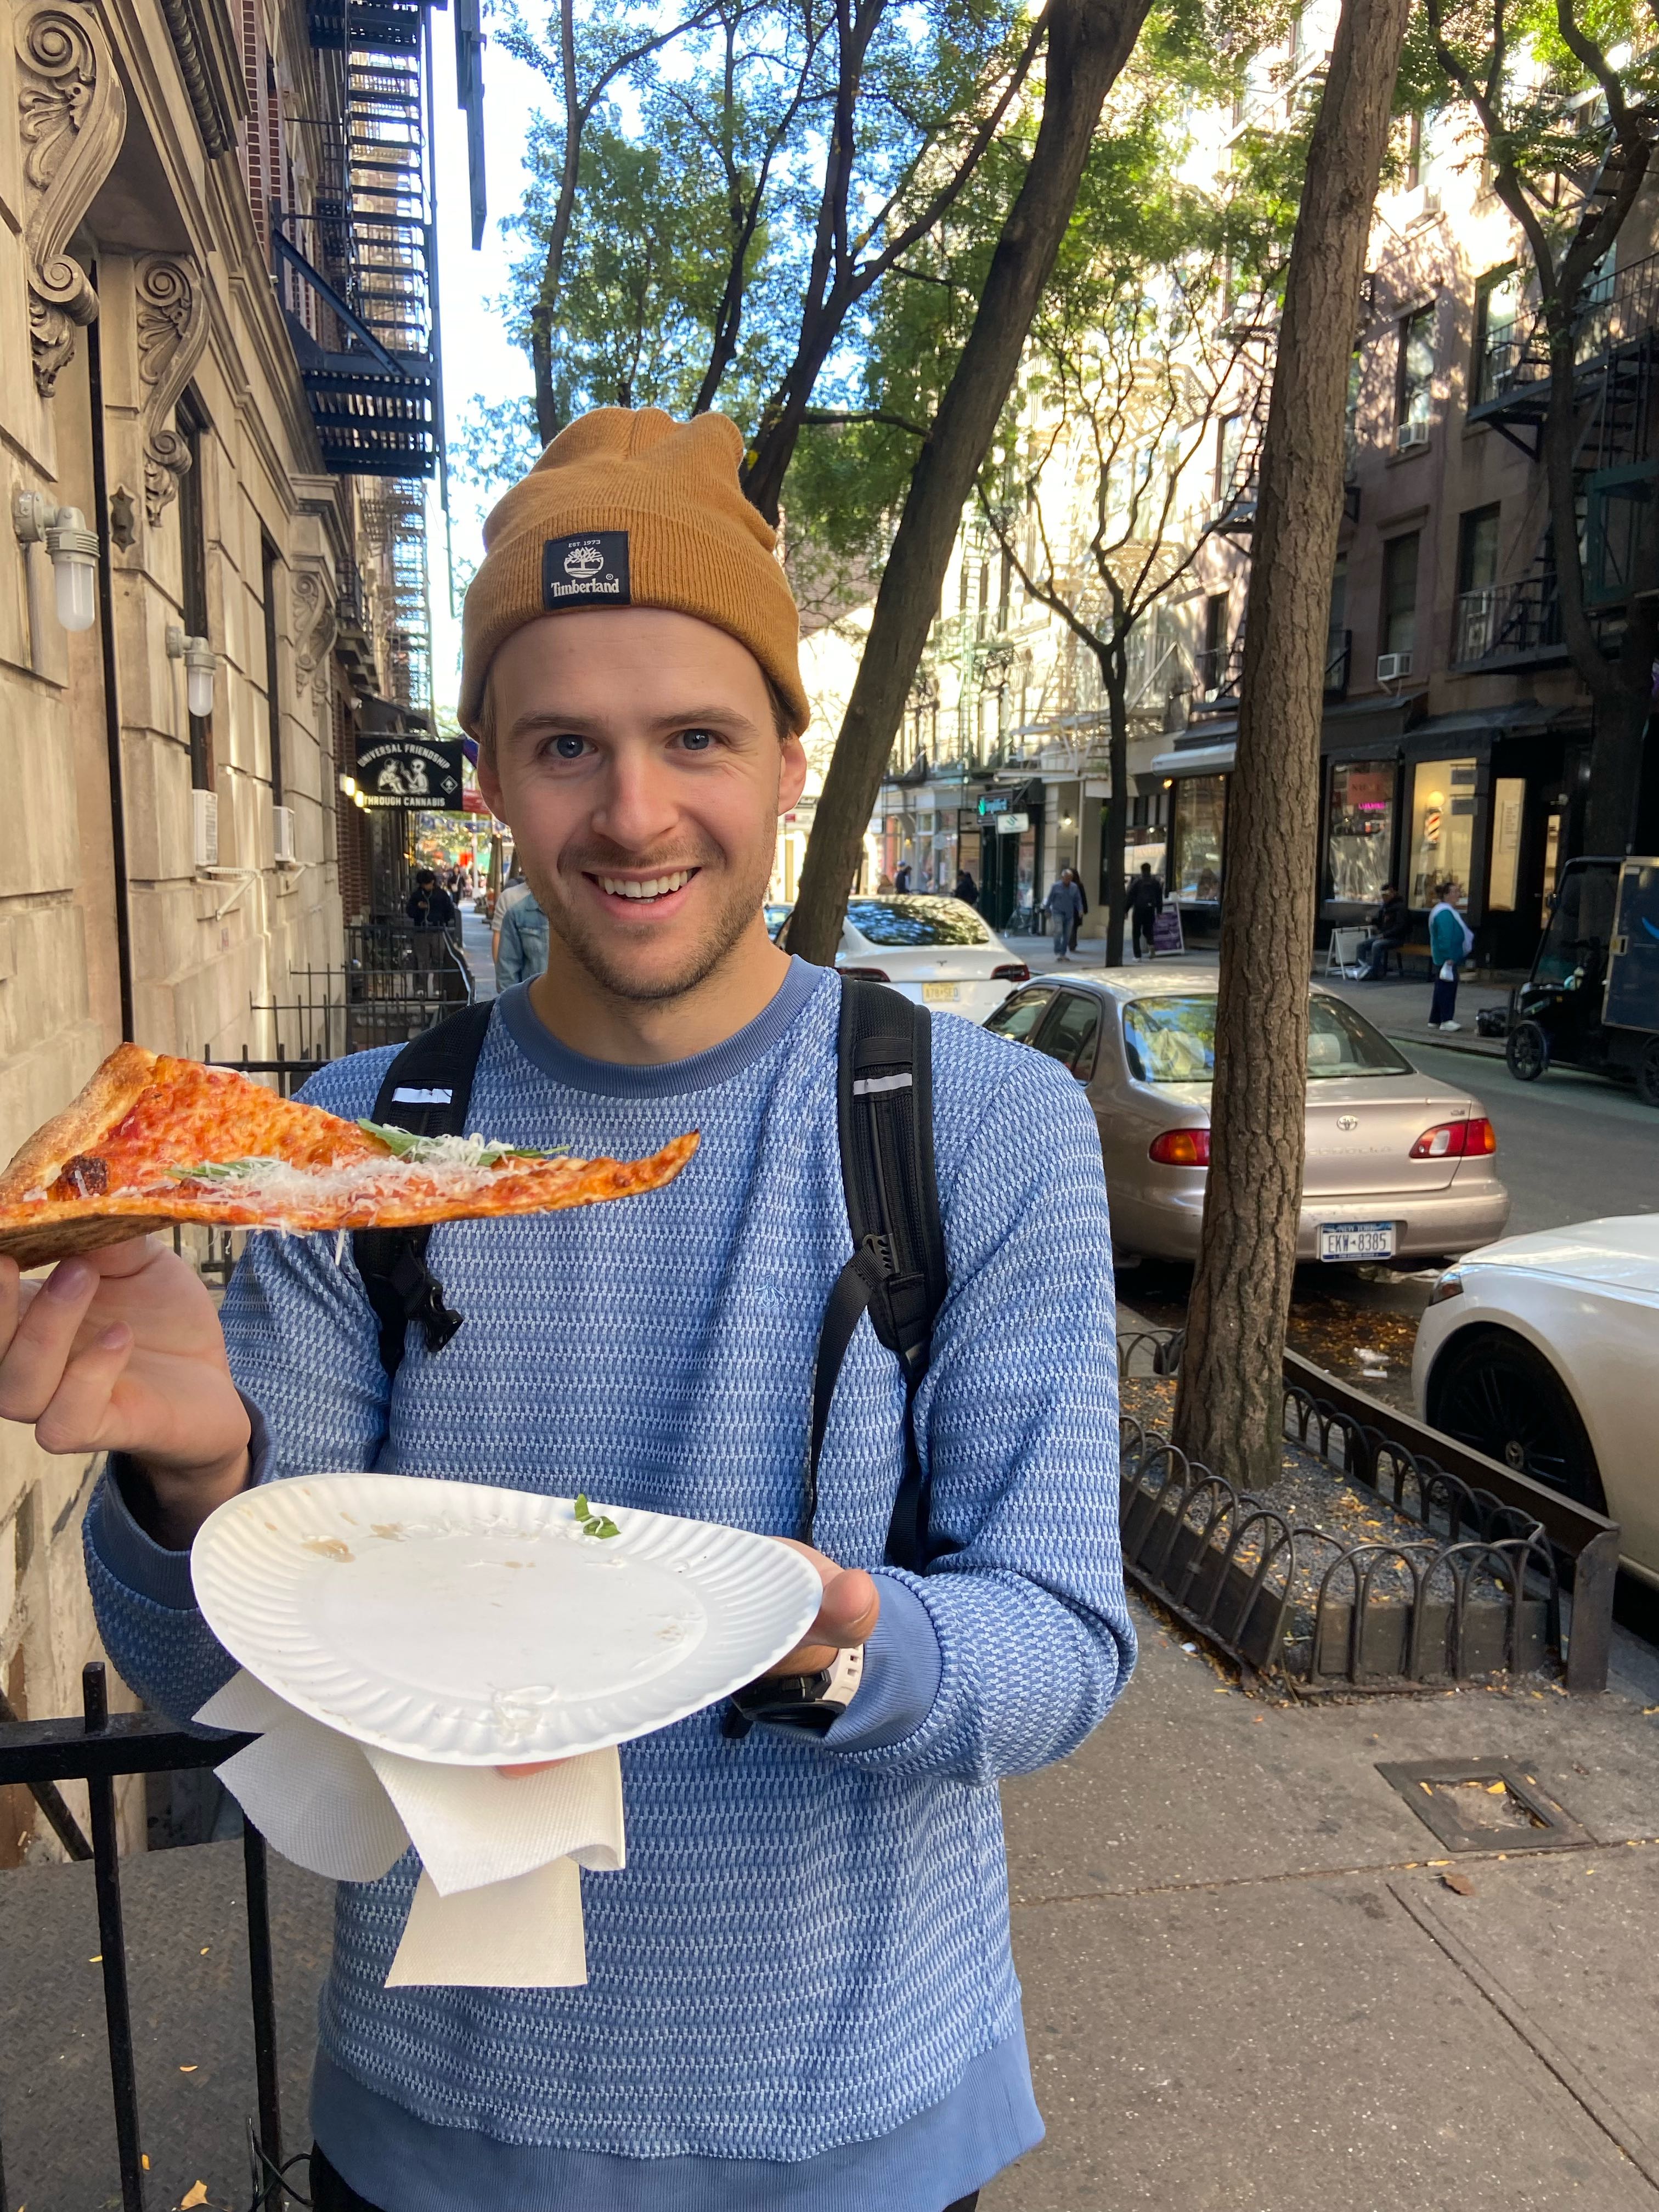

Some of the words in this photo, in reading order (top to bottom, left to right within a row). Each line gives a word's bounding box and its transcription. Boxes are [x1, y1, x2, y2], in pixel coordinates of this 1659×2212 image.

[551, 578, 620, 597] Timberland
[357, 743, 402, 768] UNIVERSAL
[404, 743, 451, 769] FRIENDSHIP
[364, 796, 402, 806] THROUGH
[404, 797, 445, 807] CANNABIS
